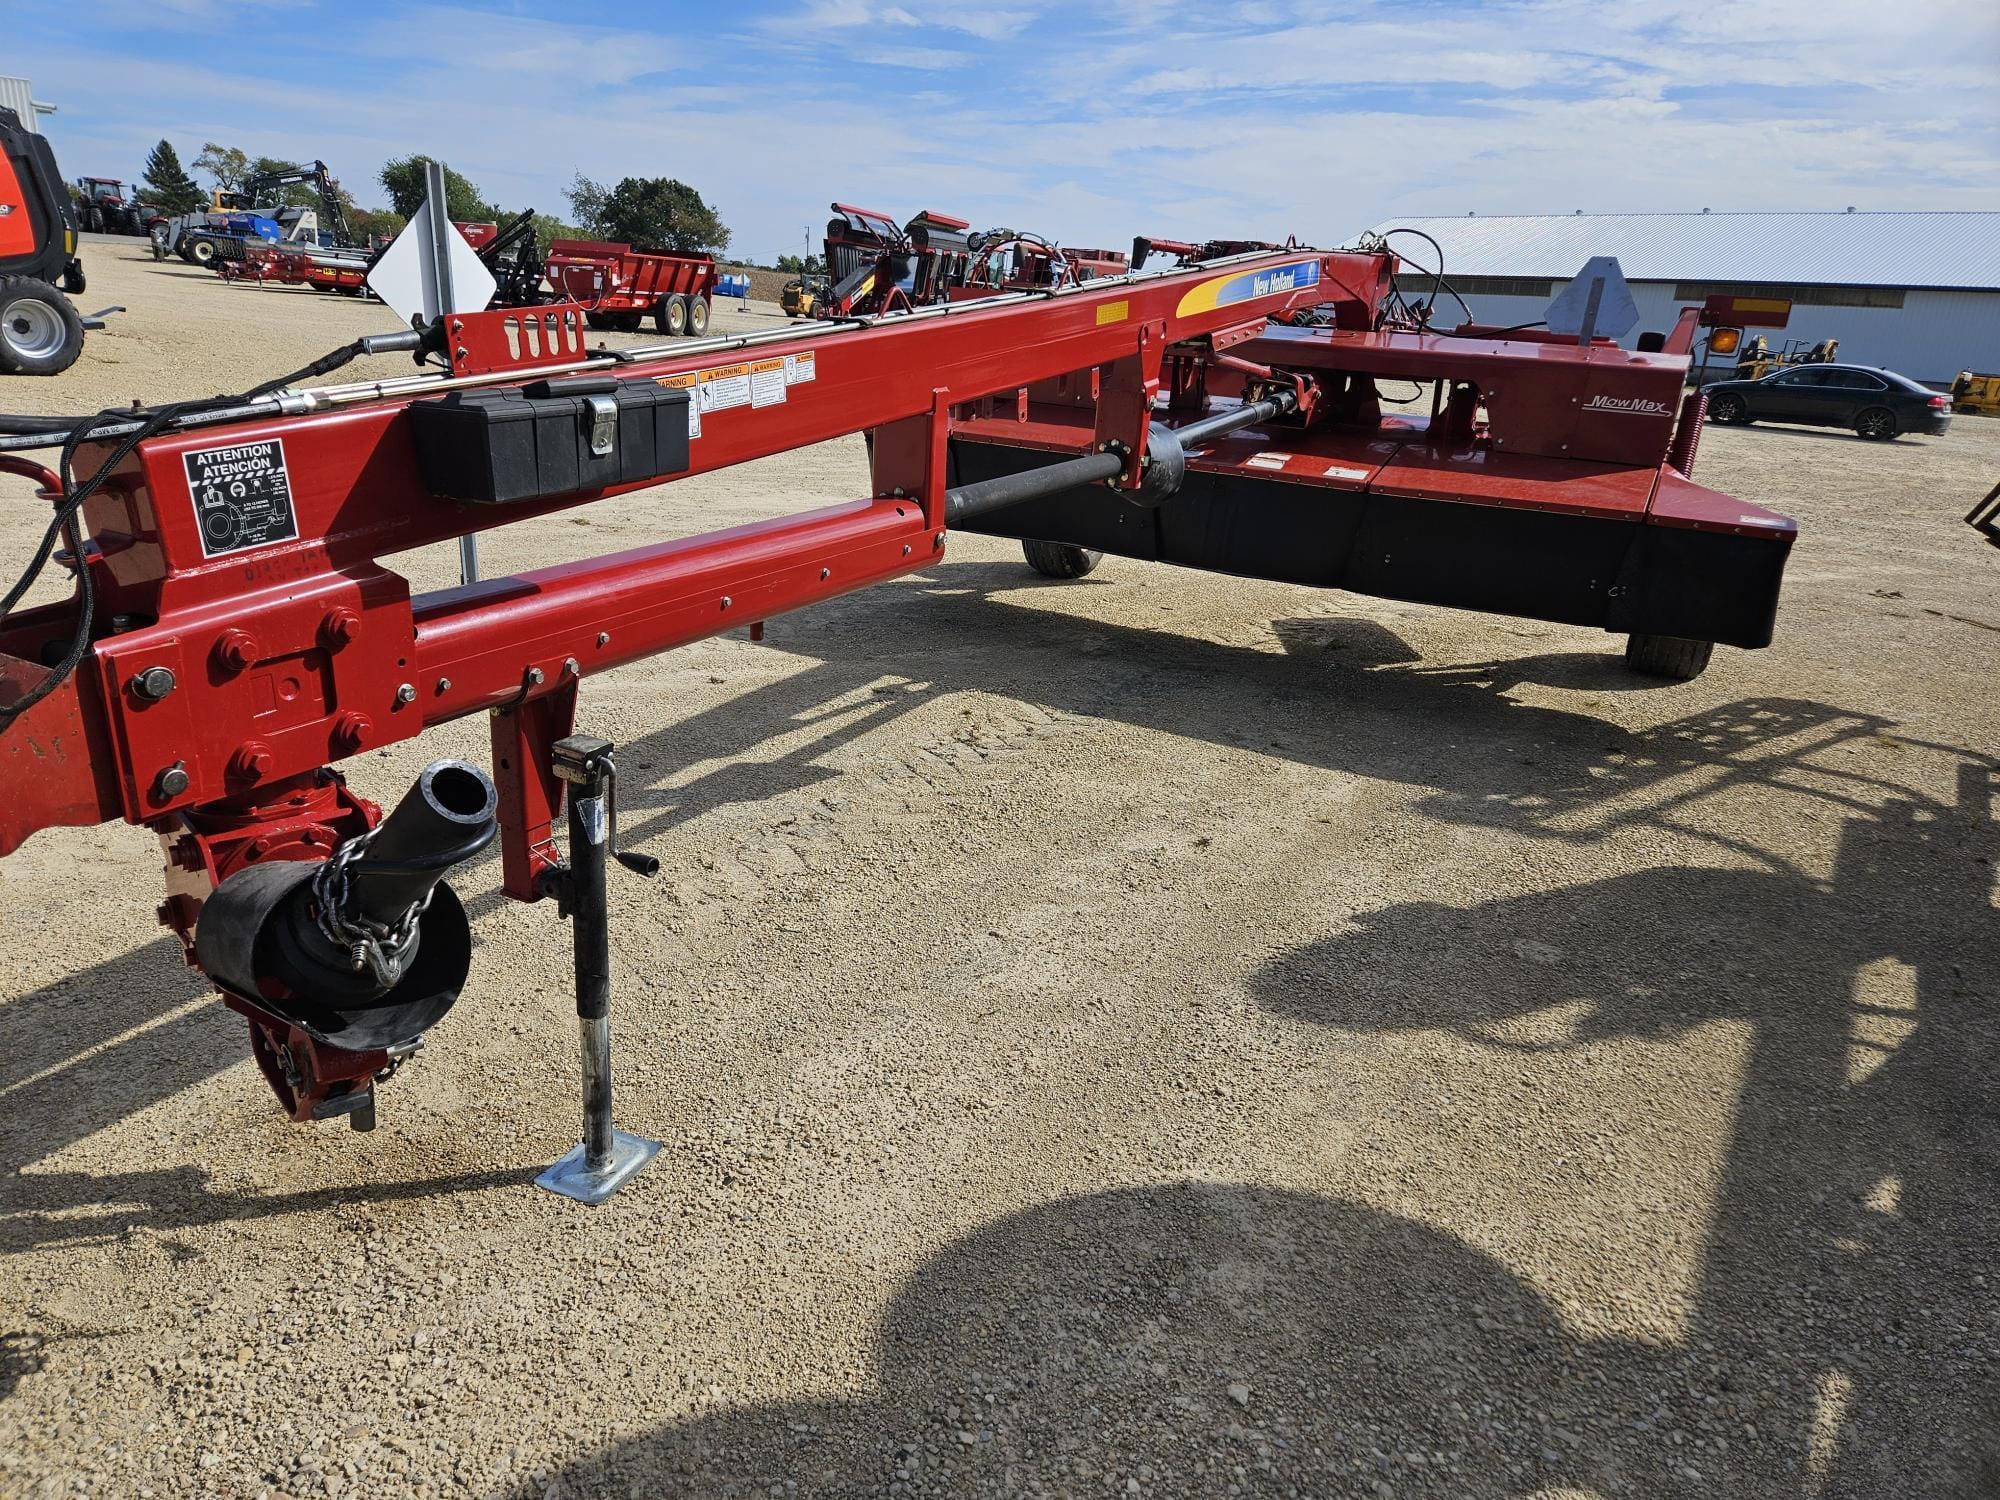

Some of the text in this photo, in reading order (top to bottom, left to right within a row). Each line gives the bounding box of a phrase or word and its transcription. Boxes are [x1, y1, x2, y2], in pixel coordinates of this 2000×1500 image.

[1252, 269, 1295, 296] New Holland
[714, 367, 742, 378] WARNING
[759, 361, 781, 371] WARNING
[197, 444, 272, 466] ATTENTION
[203, 457, 270, 478] ATENCIÓN
